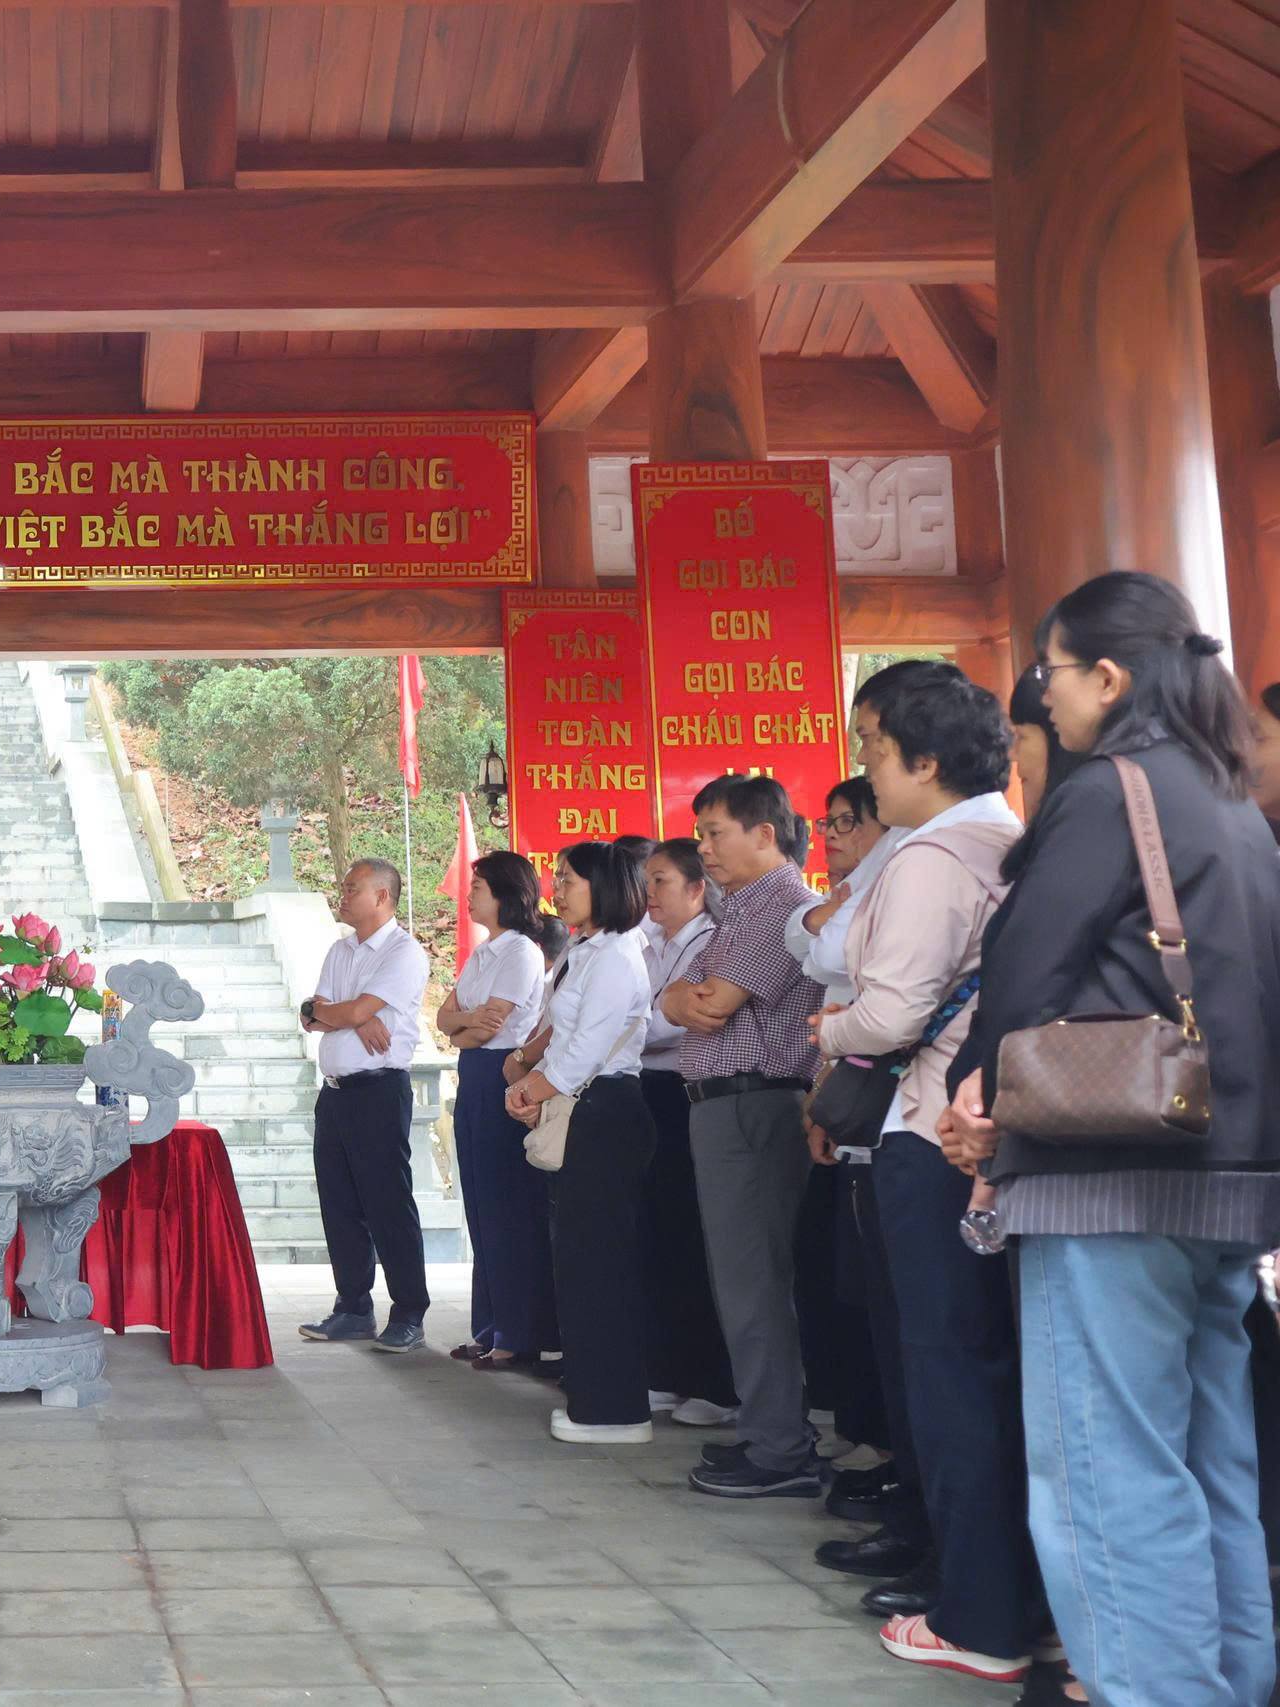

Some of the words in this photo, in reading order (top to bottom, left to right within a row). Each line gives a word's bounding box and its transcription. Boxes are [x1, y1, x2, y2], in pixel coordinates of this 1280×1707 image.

[14, 447, 94, 496] BẮC
[109, 453, 169, 494] MÀ
[182, 452, 327, 493] THÀNH
[342, 451, 465, 493] CÔNG,
[80, 501, 160, 548] BẮC
[175, 505, 236, 547] MÀ
[248, 499, 390, 547] THẮNG
[713, 495, 755, 538] BỐ
[678, 559, 729, 598] GỌI
[738, 550, 797, 590] BÁC
[547, 628, 617, 660] TÂN
[710, 609, 772, 642] CON
[544, 671, 624, 704] NIÊN
[684, 661, 736, 701] GỌI
[745, 654, 805, 693] BÁC
[537, 714, 633, 747] TOÀN
[661, 707, 744, 746] CHÁU
[753, 701, 835, 745] CHẮT
[525, 752, 647, 790] THẮNG
[558, 807, 618, 841] ĐẠI
